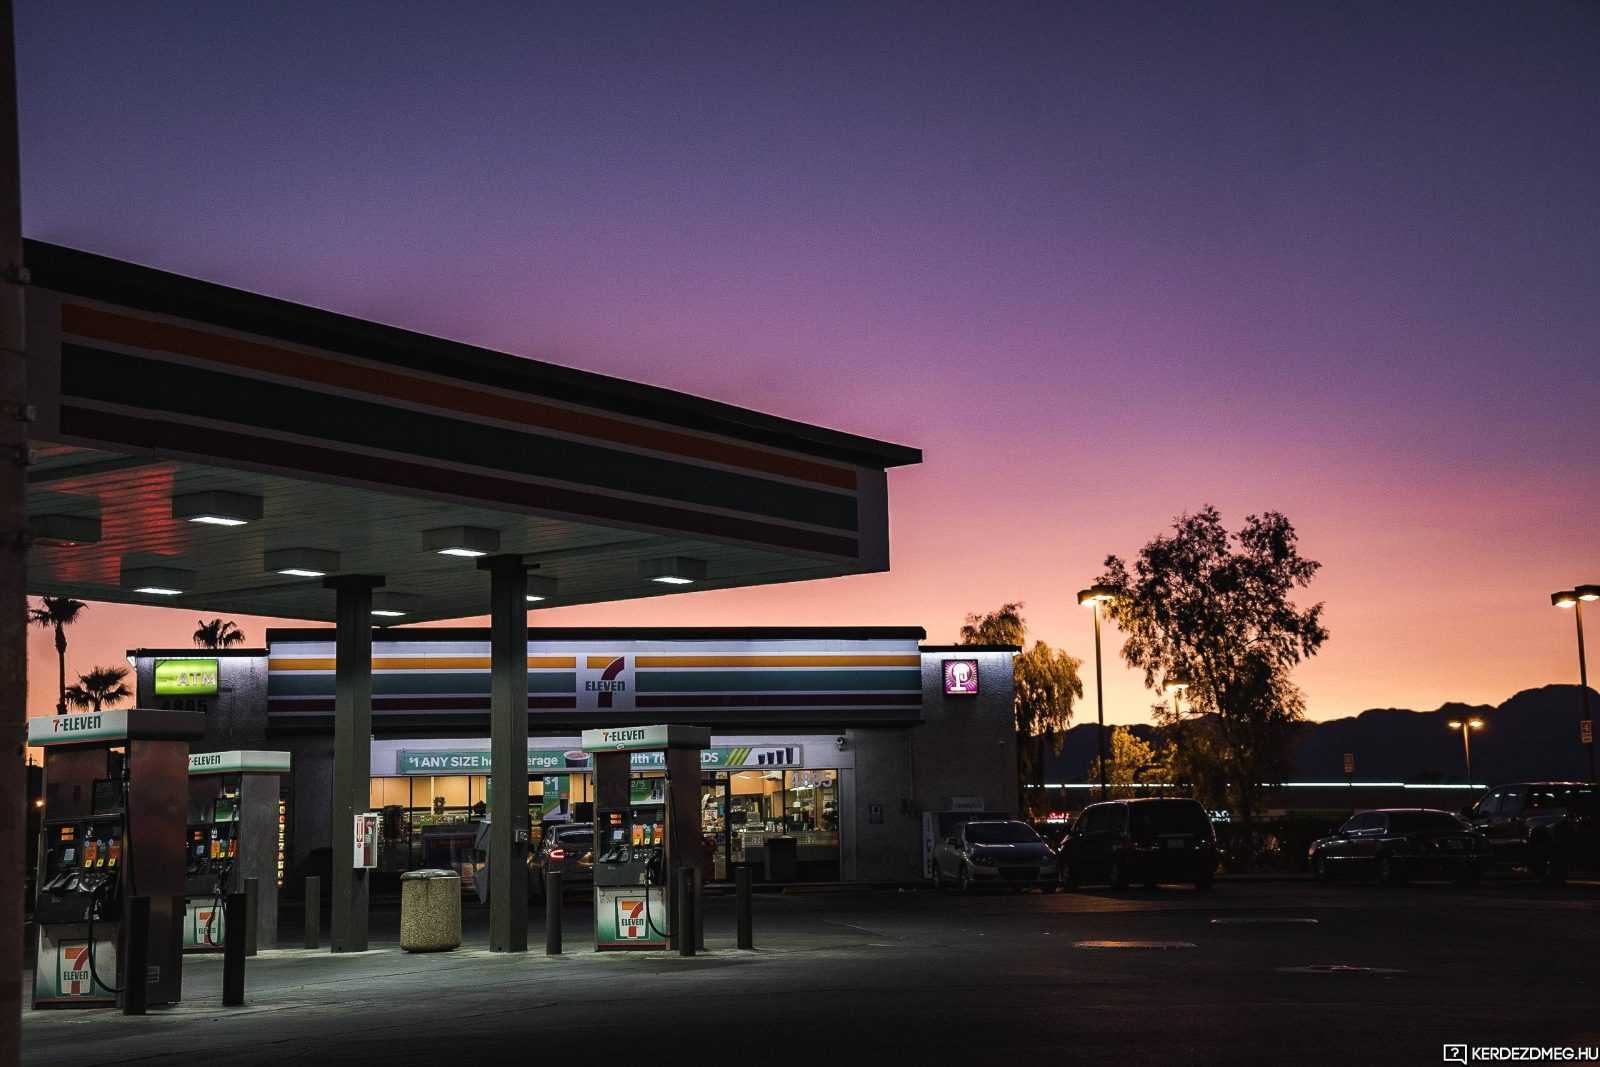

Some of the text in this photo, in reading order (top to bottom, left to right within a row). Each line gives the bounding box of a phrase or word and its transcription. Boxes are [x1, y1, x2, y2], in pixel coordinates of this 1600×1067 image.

[176, 672, 216, 687] ATM
[420, 756, 448, 768] ANY
[450, 756, 480, 768] SIZE
